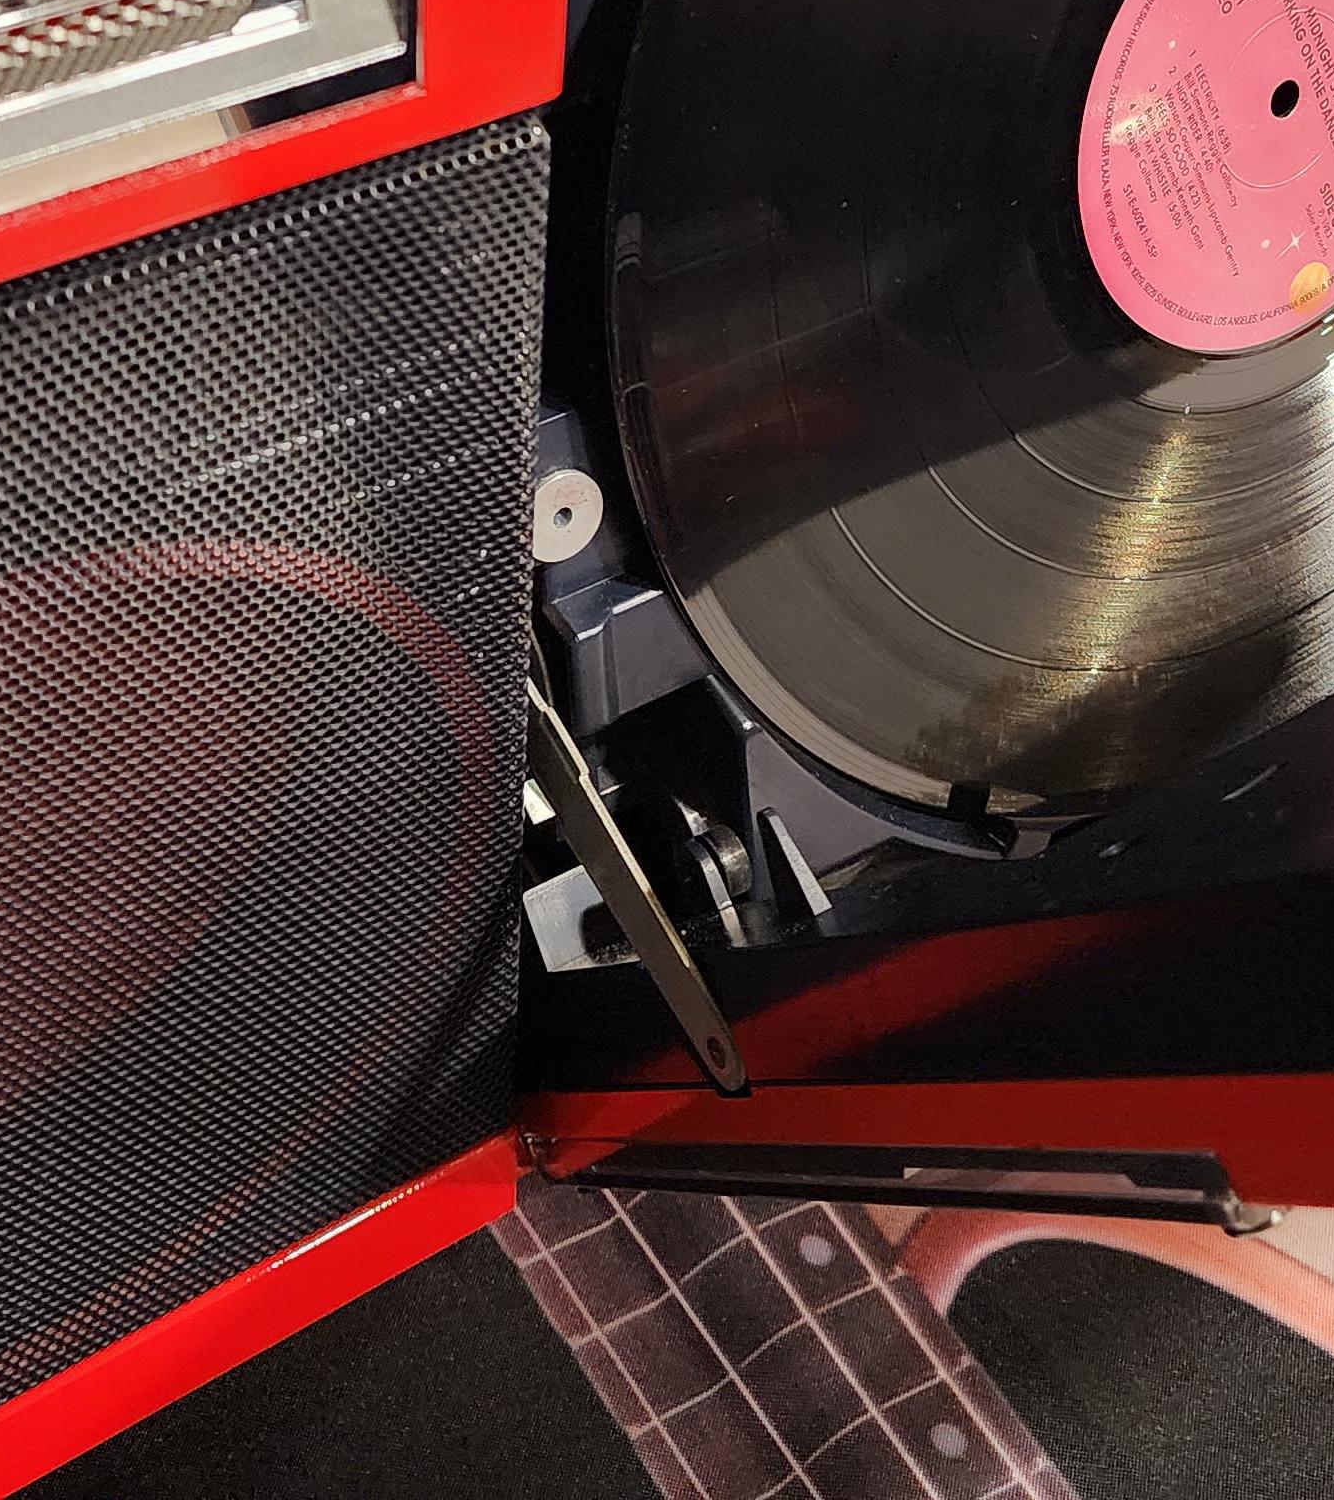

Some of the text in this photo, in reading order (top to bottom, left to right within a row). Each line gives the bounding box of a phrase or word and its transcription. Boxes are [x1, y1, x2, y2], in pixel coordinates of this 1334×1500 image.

[1193, 62, 1221, 122] ELECTRICITY
[1300, 42, 1317, 70] ON
[1311, 67, 1327, 100] THE
[1154, 97, 1171, 128] FEELS
[1165, 126, 1178, 144] SO
[1173, 80, 1193, 113] NIGHT
[1187, 112, 1204, 143] RIDER
[1183, 71, 1197, 91] Bill
[1220, 163, 1239, 209] Calloway
[1124, 123, 1159, 204] Reggie Calloway
[1135, 114, 1150, 139] WET
[1143, 138, 1156, 156] MY
[1150, 155, 1172, 199] WHISTLE
[1144, 106, 1162, 145] Belinda
[1190, 224, 1206, 250] Gant
[1171, 143, 1191, 178] GOOD
